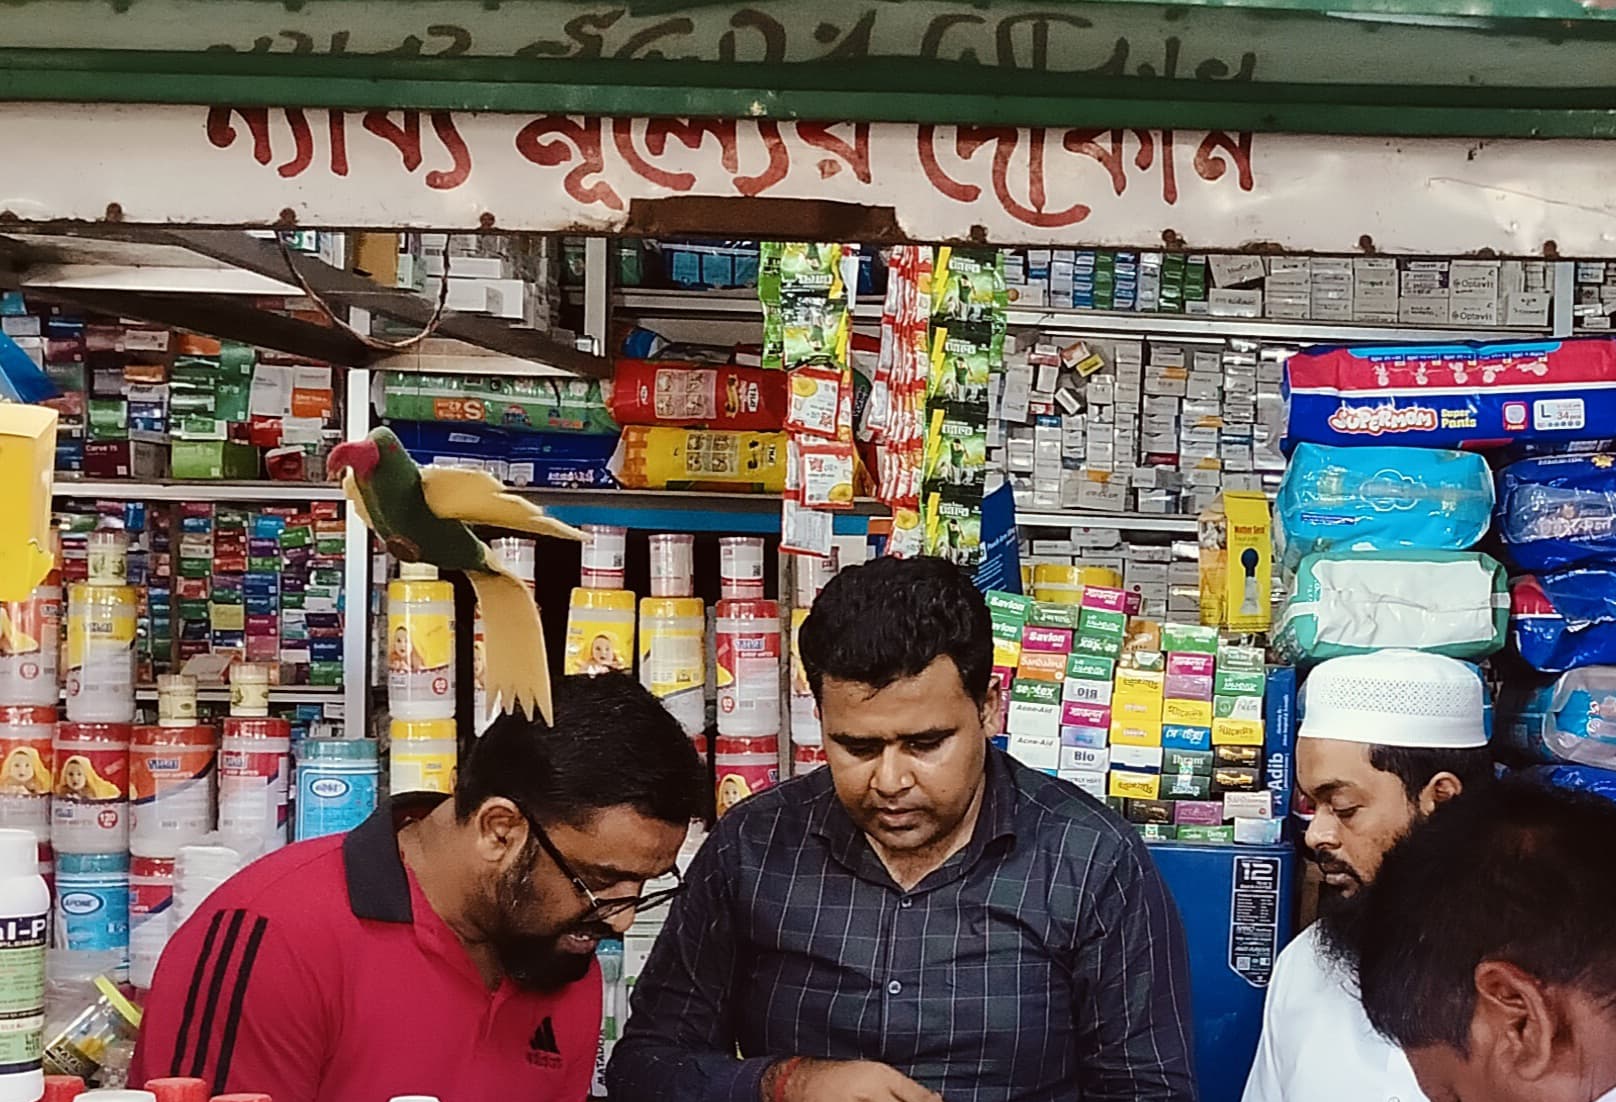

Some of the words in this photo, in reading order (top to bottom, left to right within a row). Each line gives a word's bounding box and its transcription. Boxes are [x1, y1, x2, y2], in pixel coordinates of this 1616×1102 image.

[917, 122, 1254, 229] দোকান
[1330, 406, 1435, 433] SUPERMOM
[1441, 417, 1477, 429] Pants
[989, 596, 1026, 612] Savlon
[1029, 631, 1066, 643] Savlon
[1267, 753, 1284, 791] Adib
